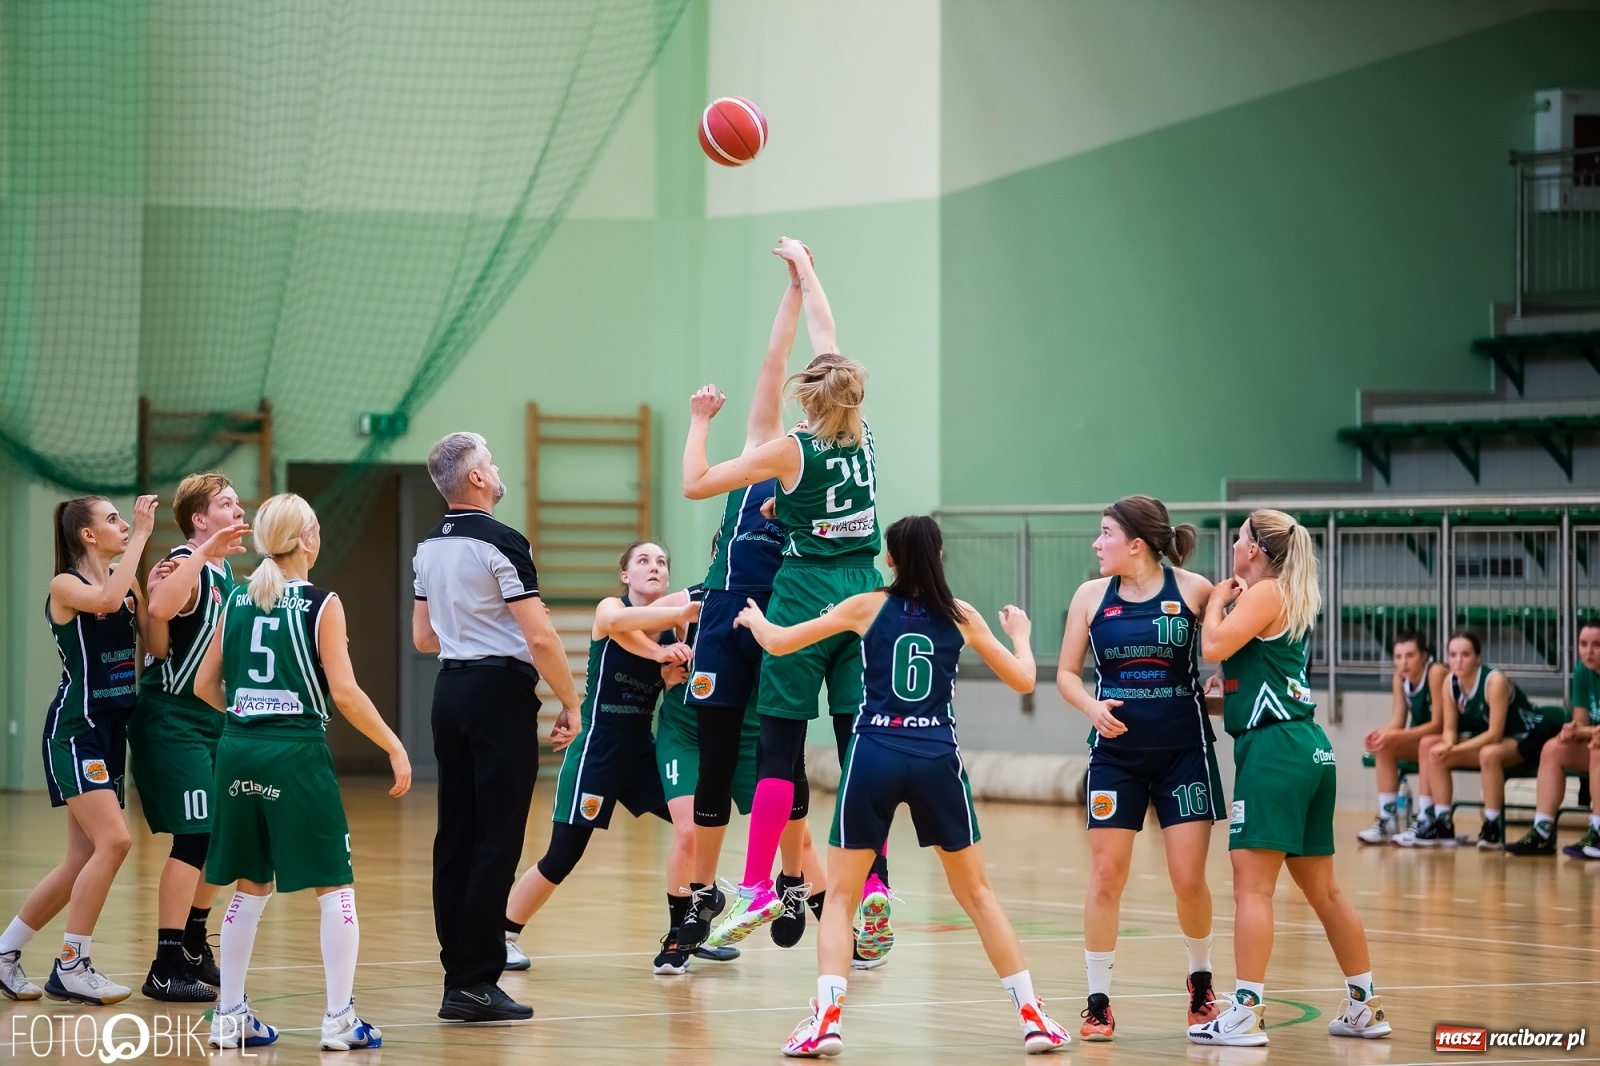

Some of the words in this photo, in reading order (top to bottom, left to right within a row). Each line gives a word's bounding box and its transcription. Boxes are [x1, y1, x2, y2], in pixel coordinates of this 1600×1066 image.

[825, 455, 875, 514] 24
[830, 518, 875, 532] WAGTEC
[273, 592, 313, 613] IBÓRZ
[1152, 615, 1189, 647] 16
[101, 648, 137, 664] OLIMPI
[248, 616, 280, 683] 5
[1104, 645, 1174, 660] OLIMPIA
[892, 633, 934, 702] 6
[1120, 670, 1167, 680] INFOSAFE
[665, 759, 680, 786] 4
[241, 780, 281, 799] Clavis
[1171, 781, 1209, 817] 16
[183, 789, 208, 820] 10
